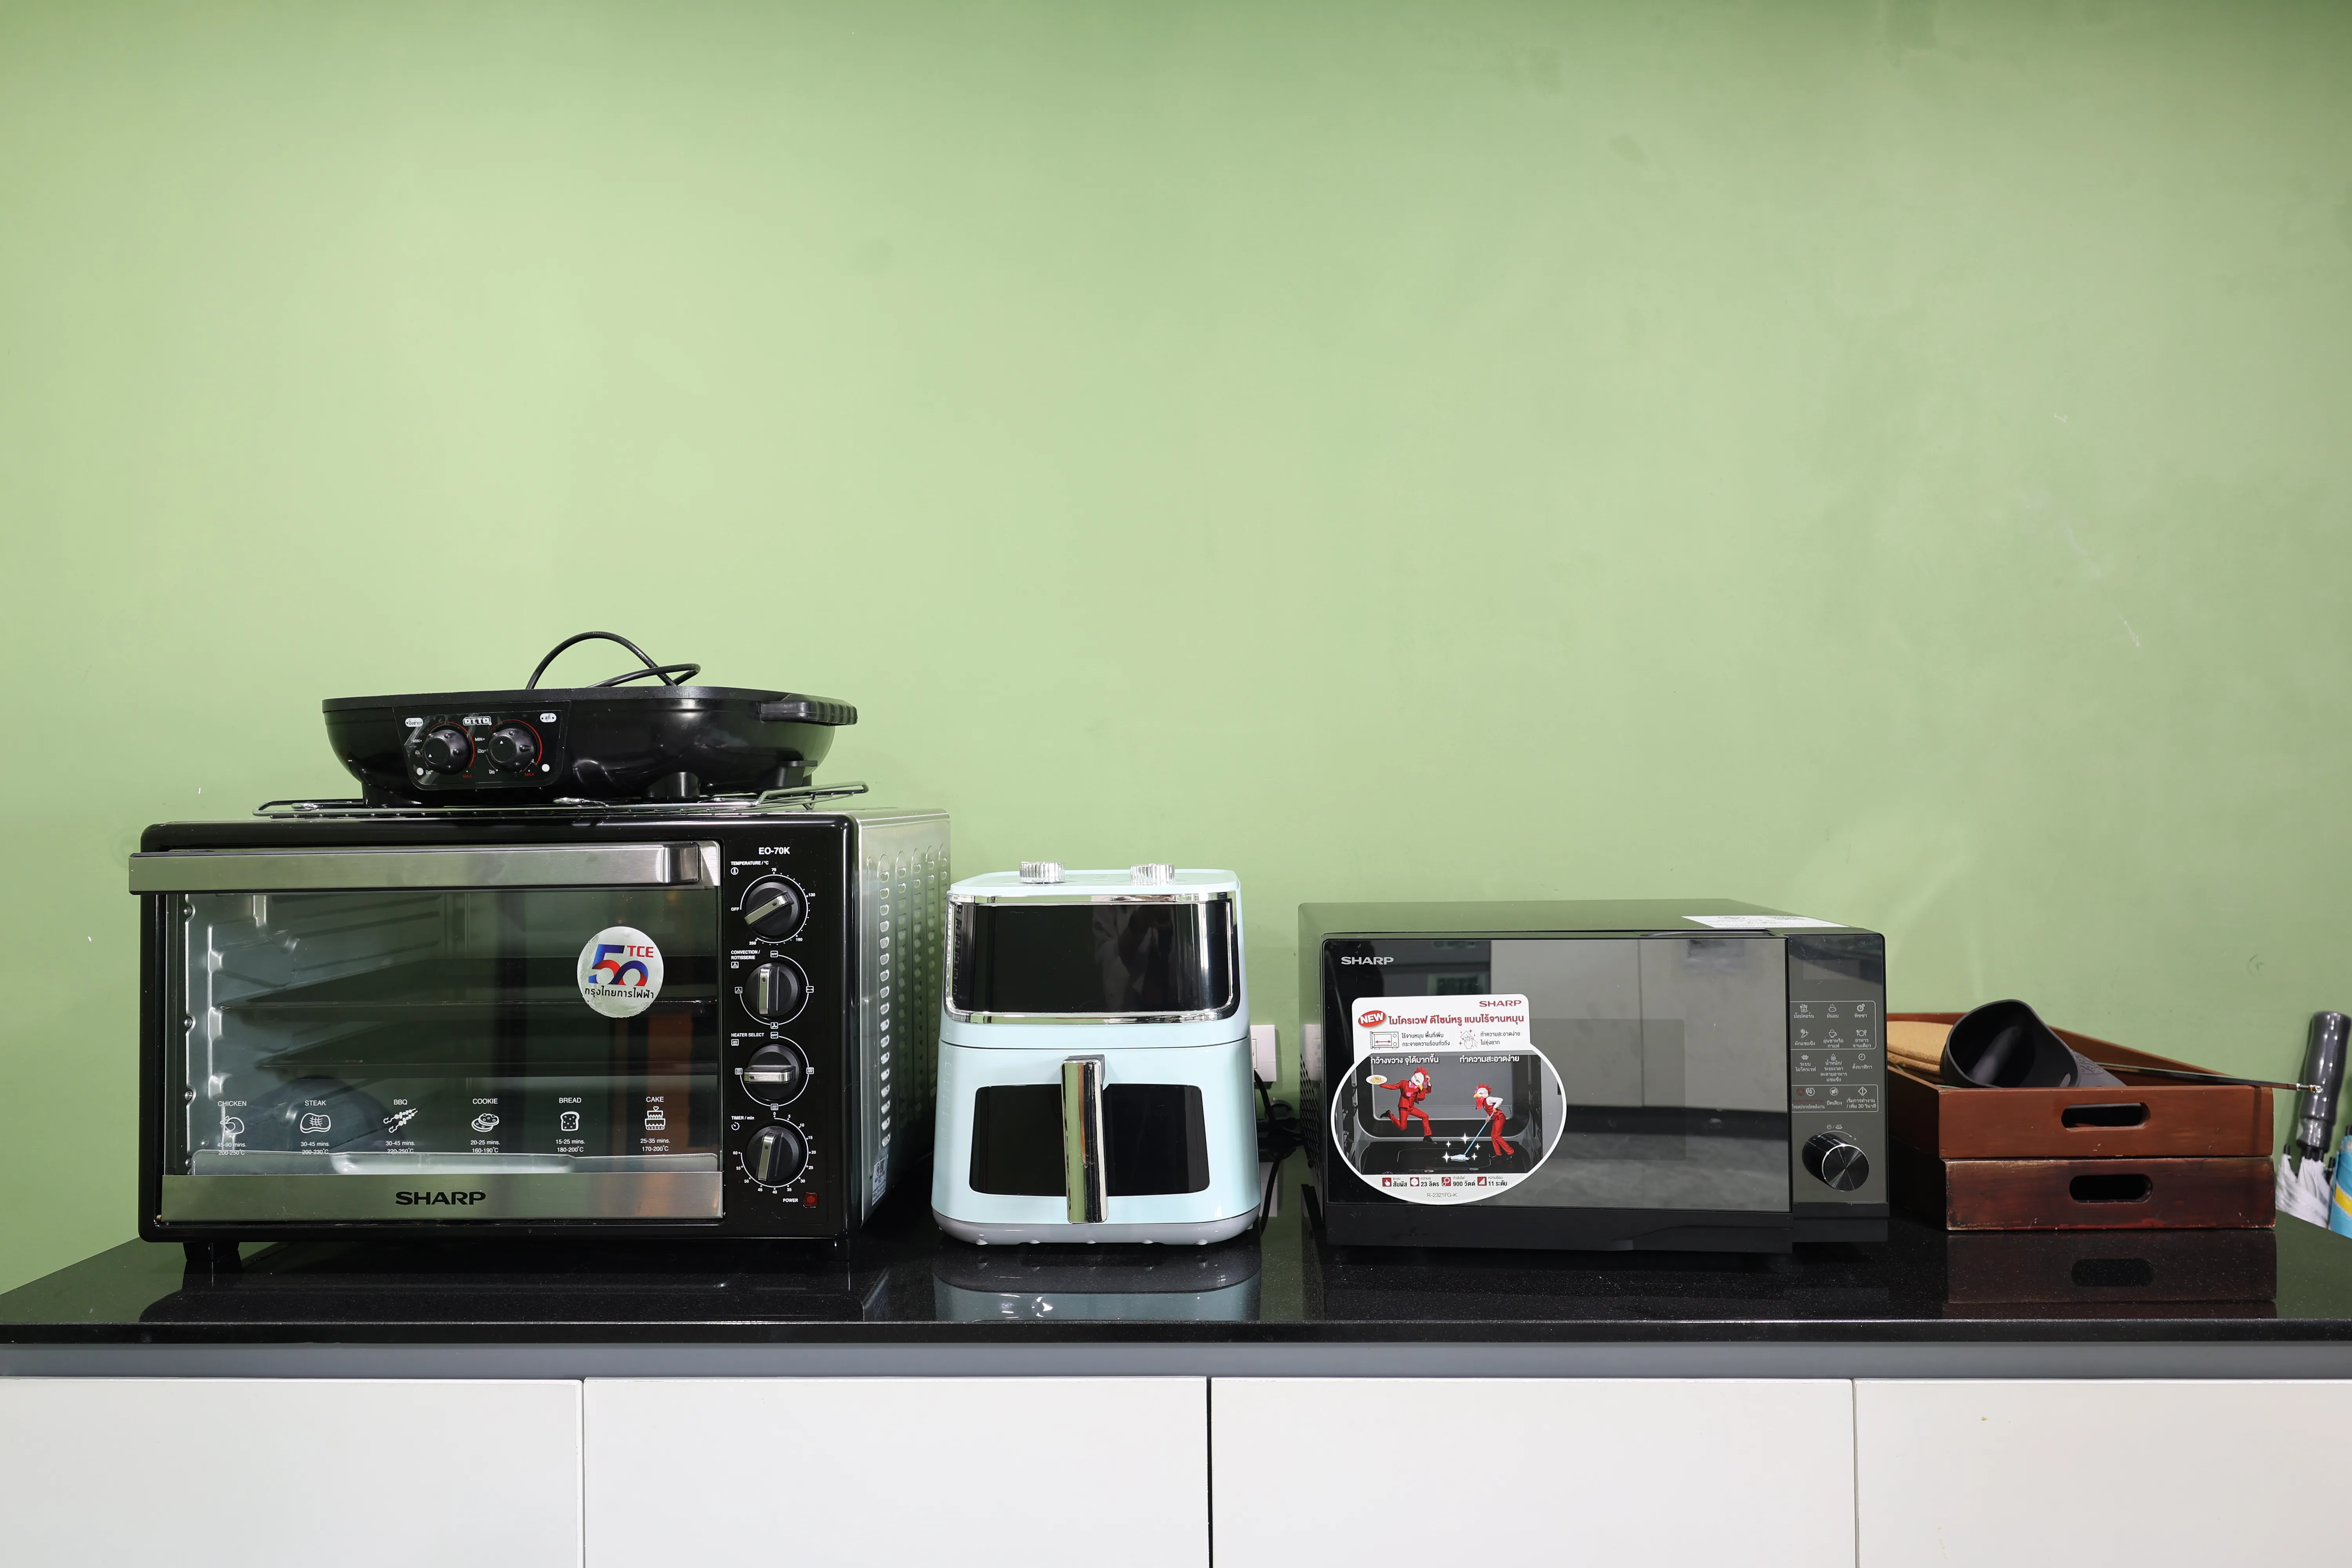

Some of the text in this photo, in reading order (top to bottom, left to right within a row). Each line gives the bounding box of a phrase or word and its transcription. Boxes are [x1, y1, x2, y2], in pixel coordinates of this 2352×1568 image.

[464, 717, 491, 725] OTTO
[627, 946, 654, 958] TCE
[1341, 956, 1394, 965] SHARP
[585, 985, 654, 998] กรุงไทยการไฟฟ้า
[1359, 1012, 1384, 1024] NEW
[1388, 1014, 1524, 1026] ไมโครเวฟ ดีไซน์หรู แบบไร้จานหมุน
[1405, 1054, 1439, 1065] จุได้มากขึ้น
[1460, 1054, 1519, 1063] ทำความสะอาดง่าย
[395, 1191, 486, 1205] SHARP
